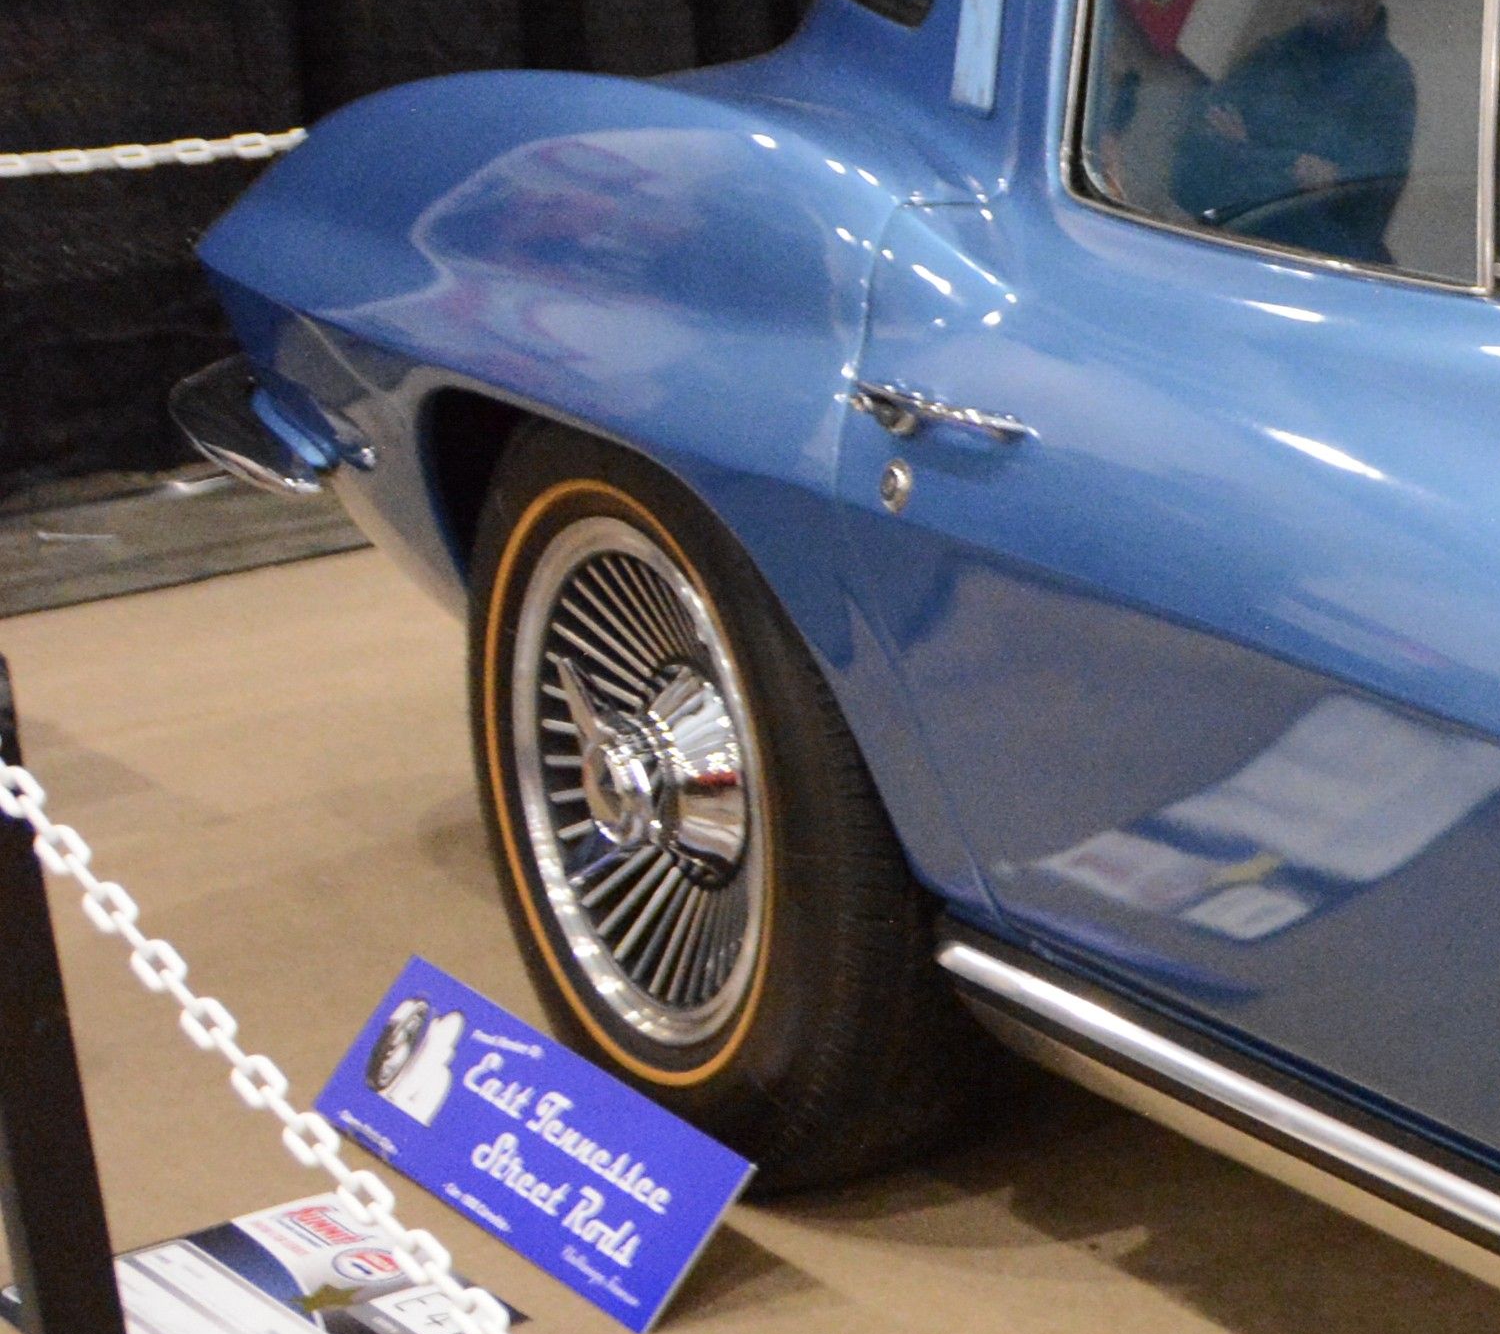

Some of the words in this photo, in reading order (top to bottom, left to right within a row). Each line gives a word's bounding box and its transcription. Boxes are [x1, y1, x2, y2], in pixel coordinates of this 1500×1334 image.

[463, 1052, 536, 1120] East
[525, 1090, 673, 1215] Tennessee
[471, 1131, 573, 1217] Street
[561, 1185, 643, 1268] Rods
